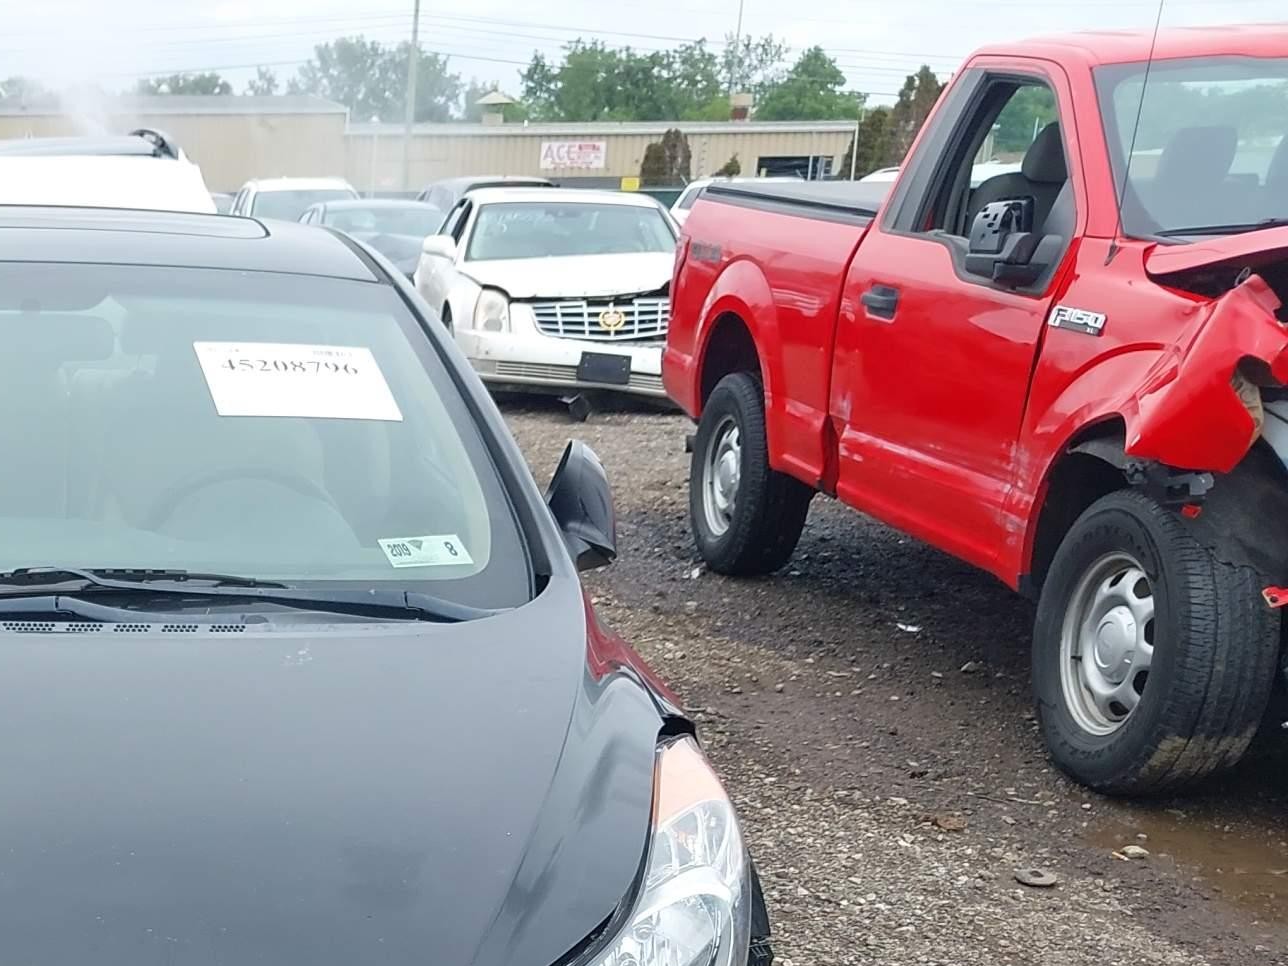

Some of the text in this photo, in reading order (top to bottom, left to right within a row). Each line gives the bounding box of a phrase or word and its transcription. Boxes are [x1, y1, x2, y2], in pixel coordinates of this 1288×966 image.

[543, 143, 577, 161] ACE
[387, 541, 458, 557] 2019 8
